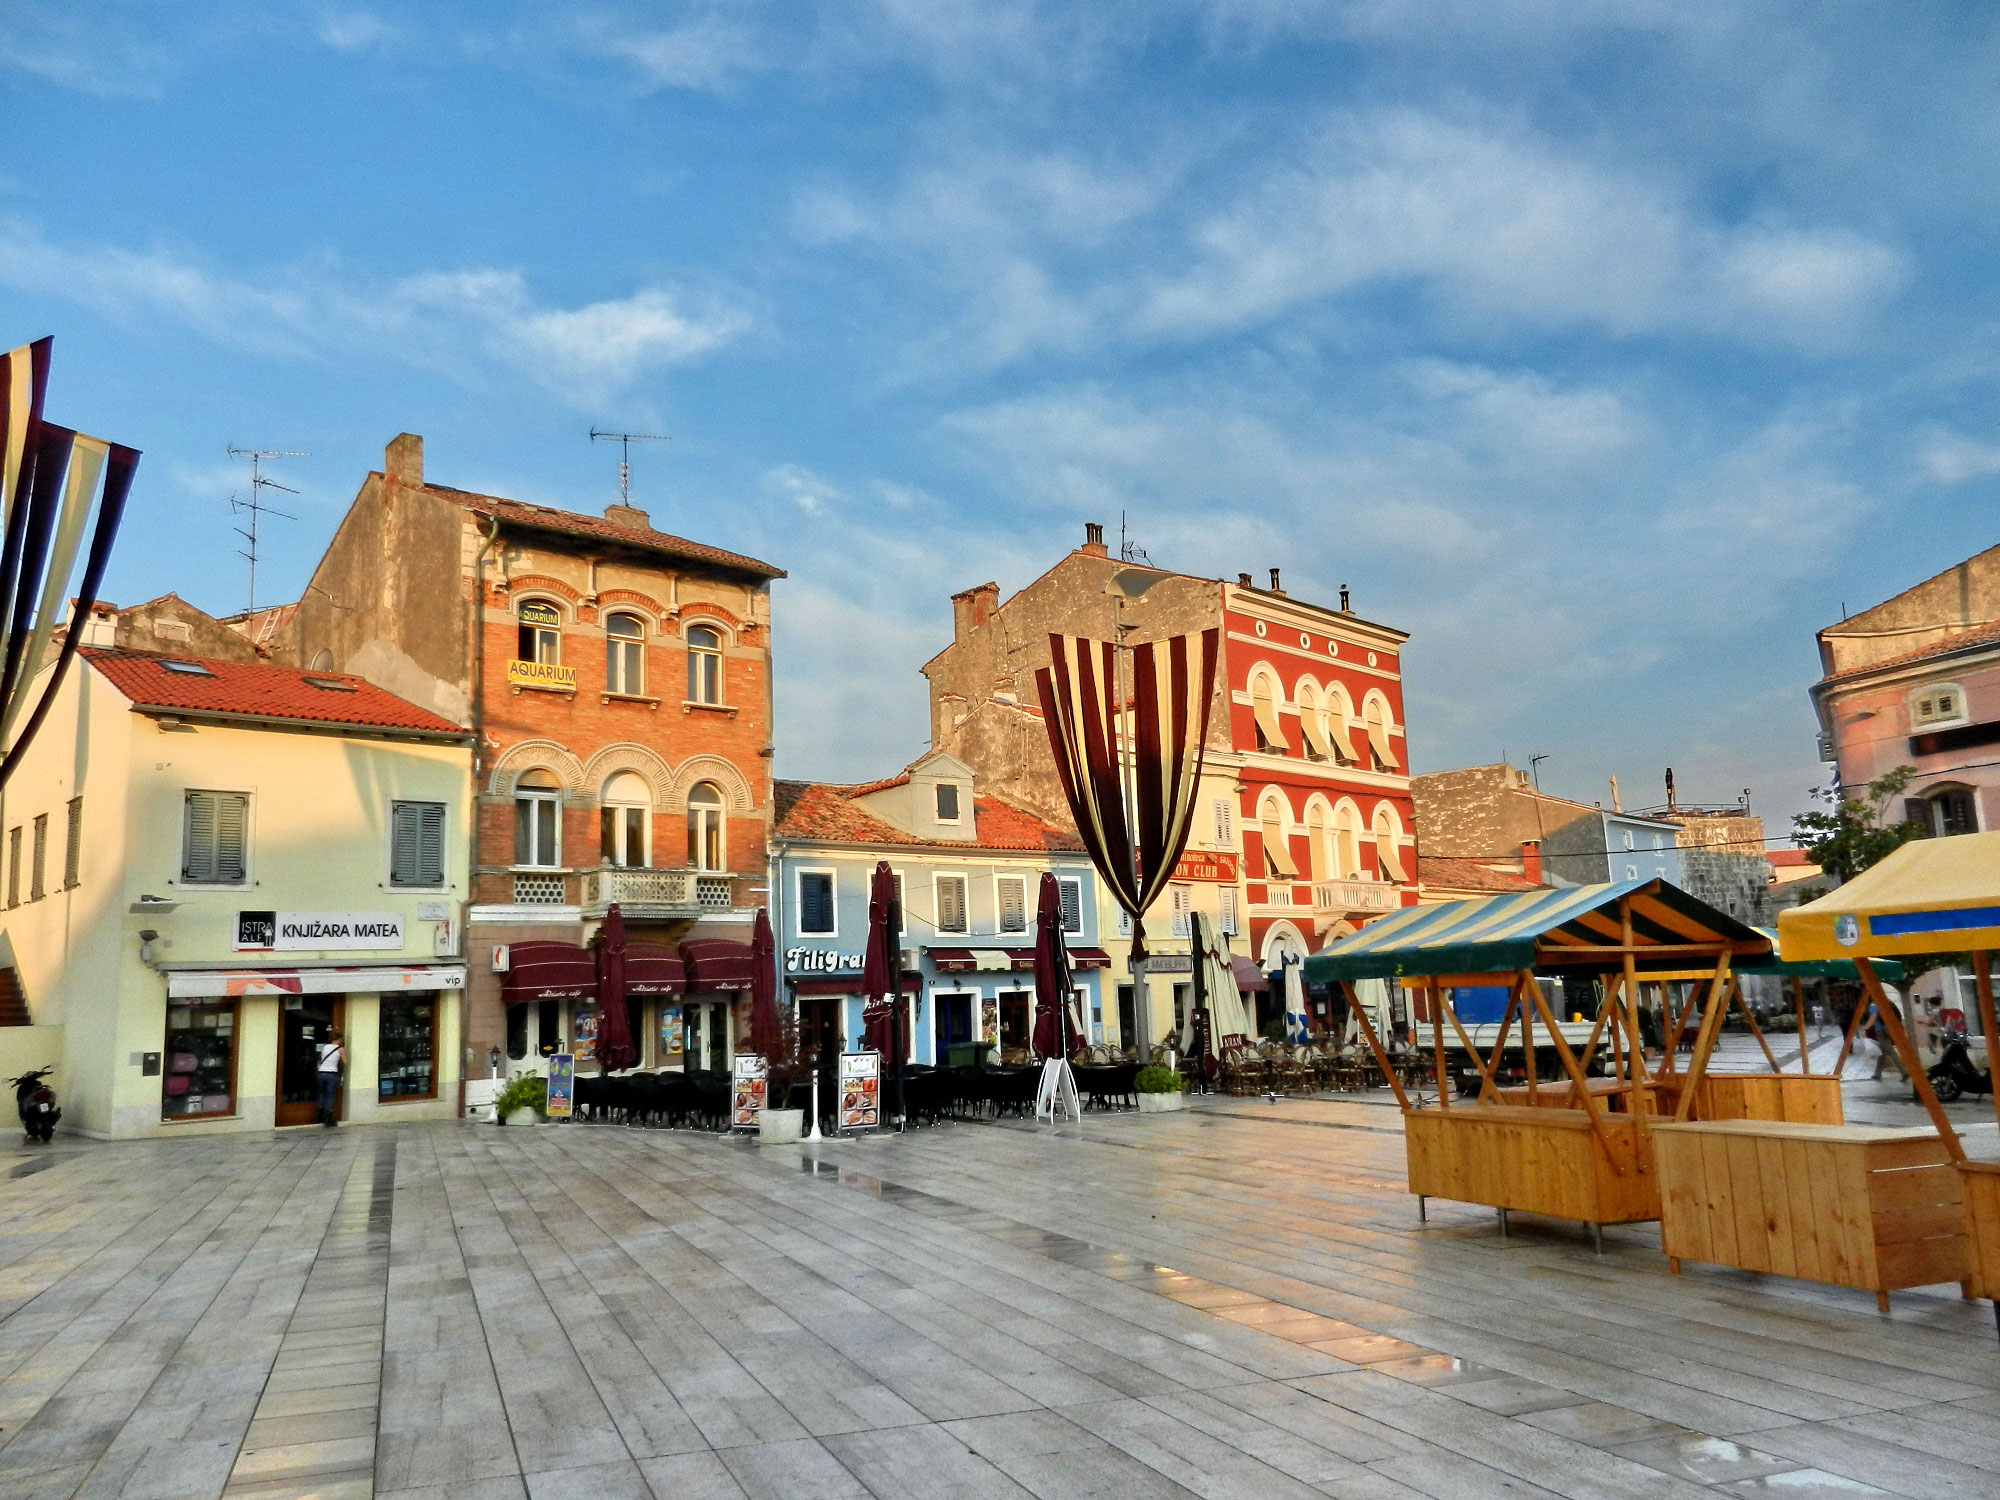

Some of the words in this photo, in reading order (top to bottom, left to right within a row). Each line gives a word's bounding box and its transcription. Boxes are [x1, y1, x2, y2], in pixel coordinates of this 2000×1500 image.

[519, 610, 557, 624] AQUARIUM
[510, 661, 576, 682] AQUARIUM
[1193, 864, 1218, 878] CLUB
[241, 921, 274, 934] ISTRA
[282, 920, 350, 938] KNJIŽARA
[354, 924, 399, 938] MATEA
[445, 975, 461, 986] vip
